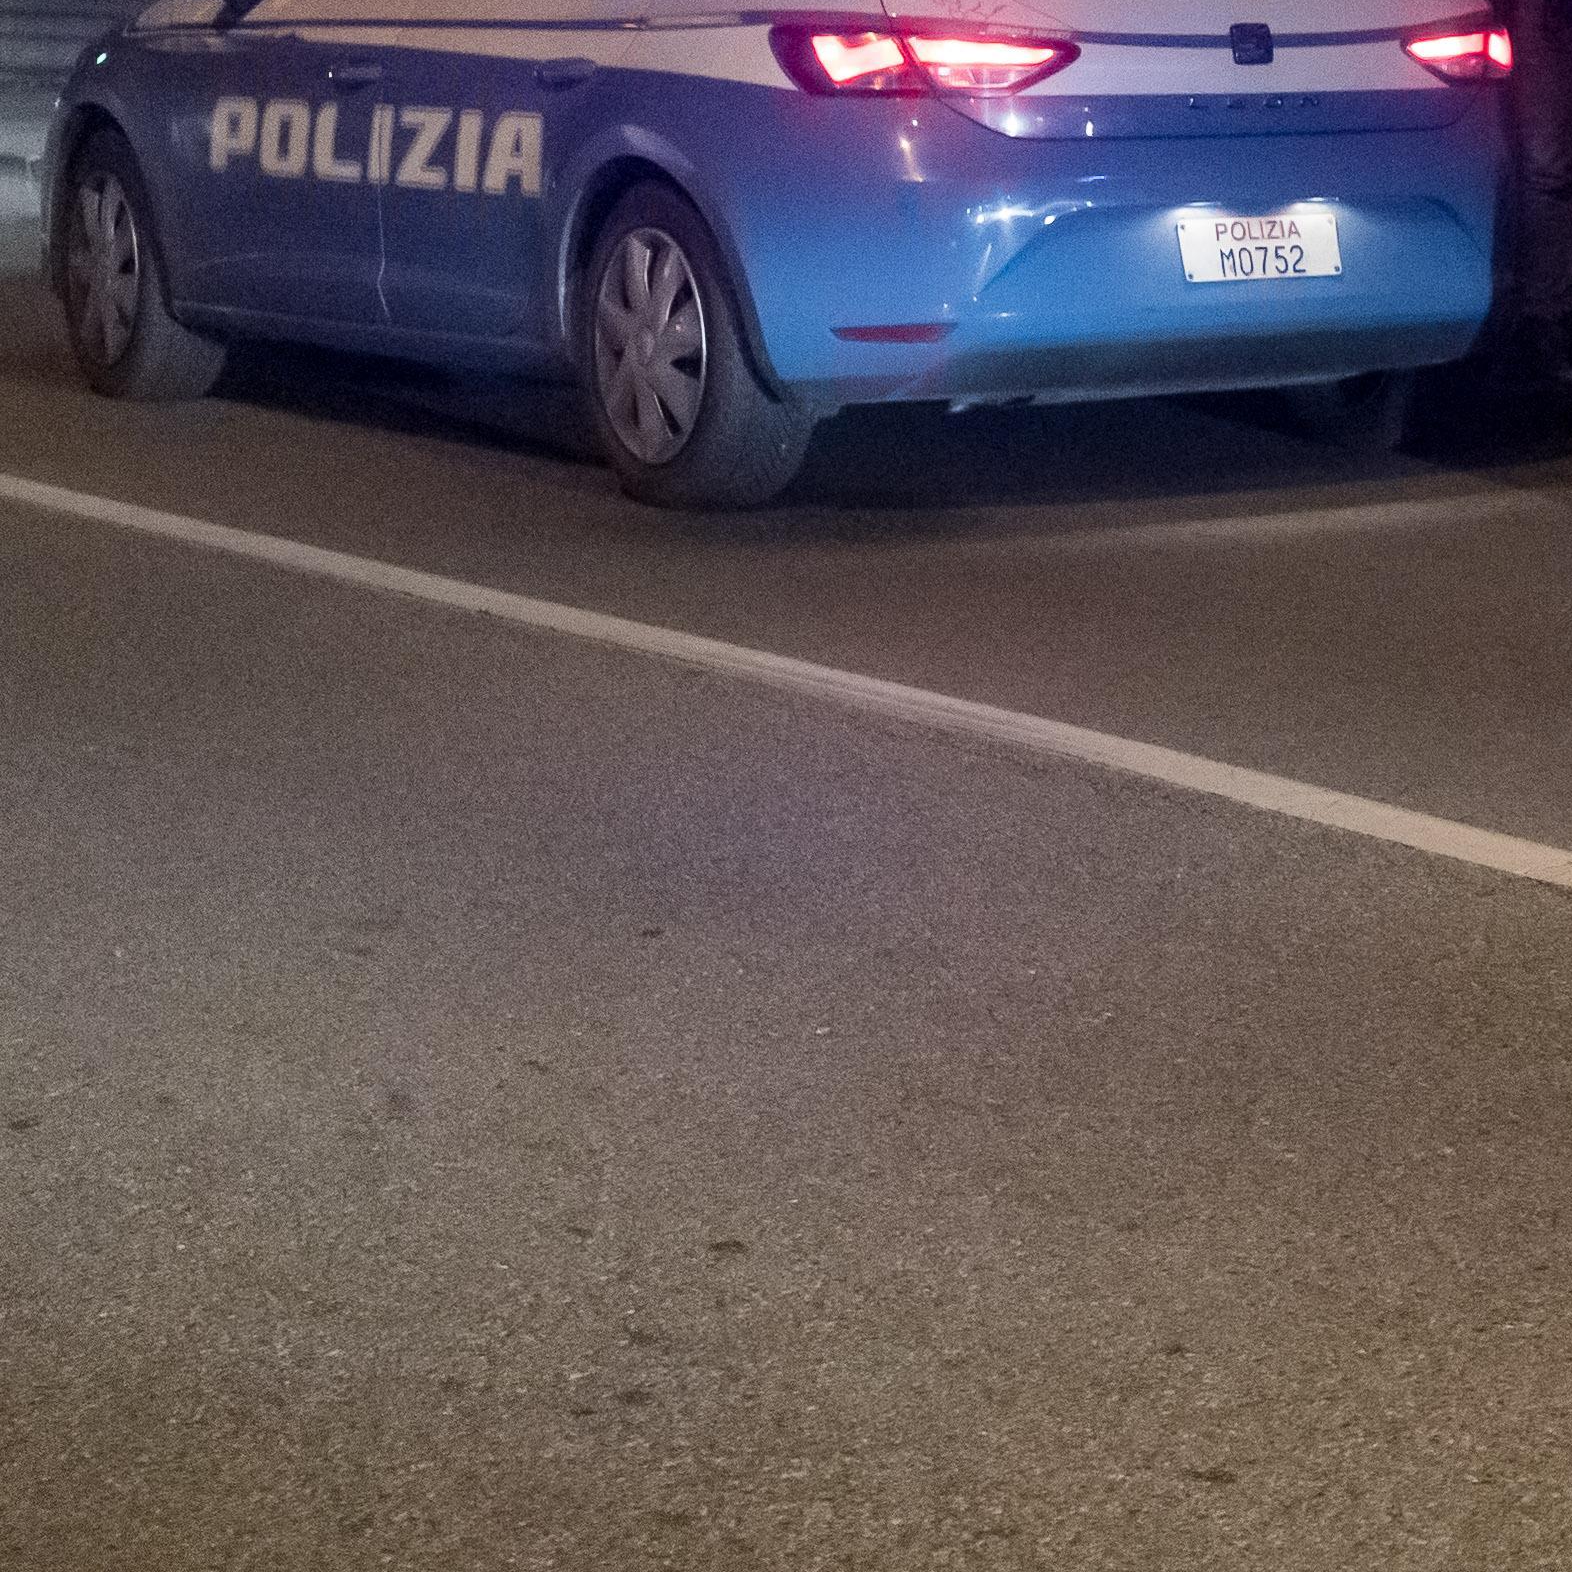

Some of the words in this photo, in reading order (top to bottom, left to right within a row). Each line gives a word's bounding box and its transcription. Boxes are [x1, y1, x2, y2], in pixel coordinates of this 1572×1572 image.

[209, 95, 543, 197] POLIZIA
[1215, 220, 1301, 241] POLIZIA
[1220, 245, 1306, 277] M0752
